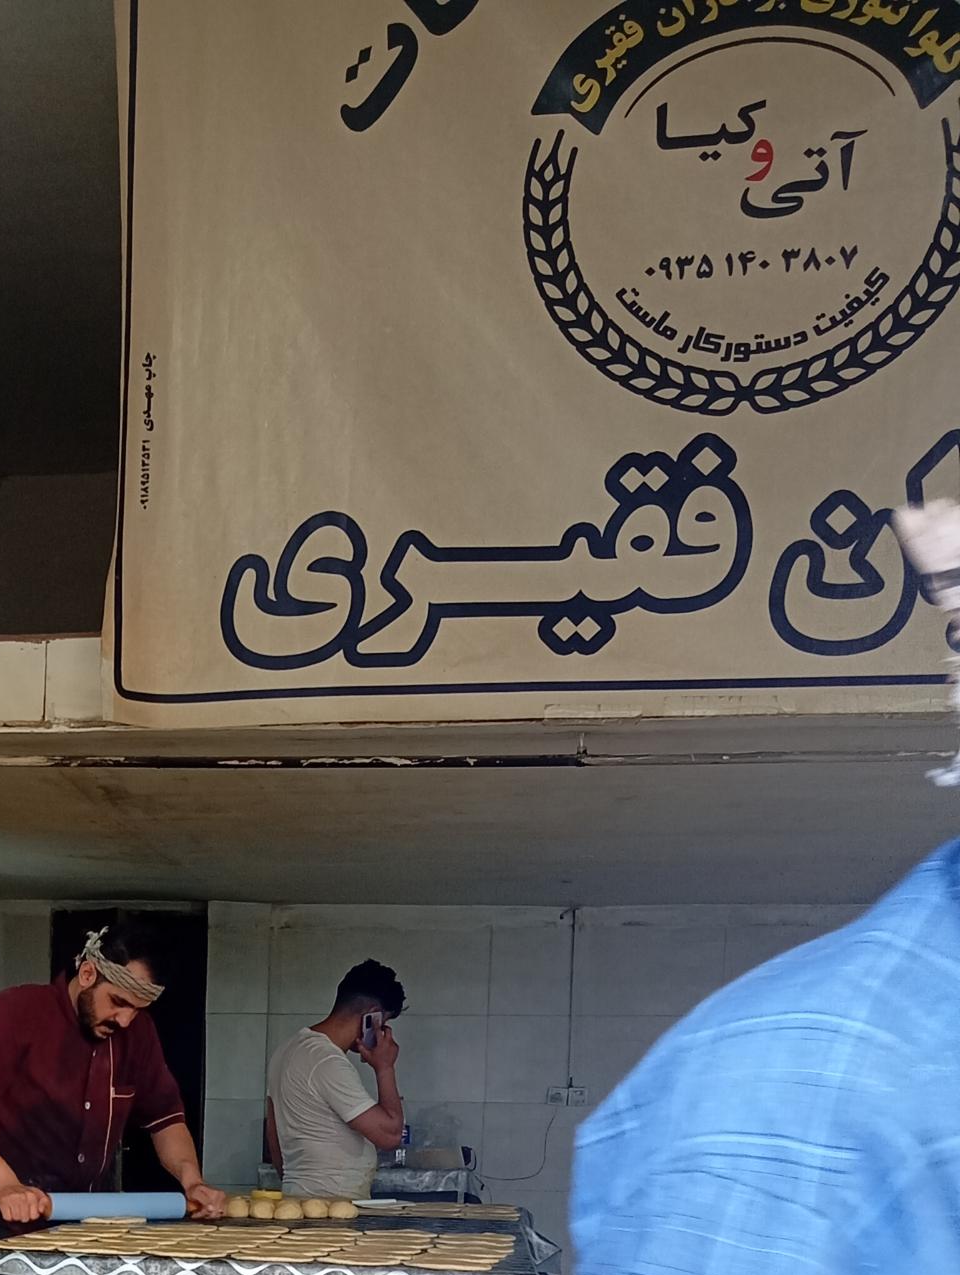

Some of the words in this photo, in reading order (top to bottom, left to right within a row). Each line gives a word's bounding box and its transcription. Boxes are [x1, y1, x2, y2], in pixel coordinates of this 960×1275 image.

[571, 14, 644, 113] فقیری
[656, 99, 767, 162] کیا
[745, 139, 774, 182] و
[741, 129, 868, 219] آتی
[615, 287, 678, 341] ماست
[812, 266, 890, 337] کیفیت
[221, 432, 753, 670] فقیری
